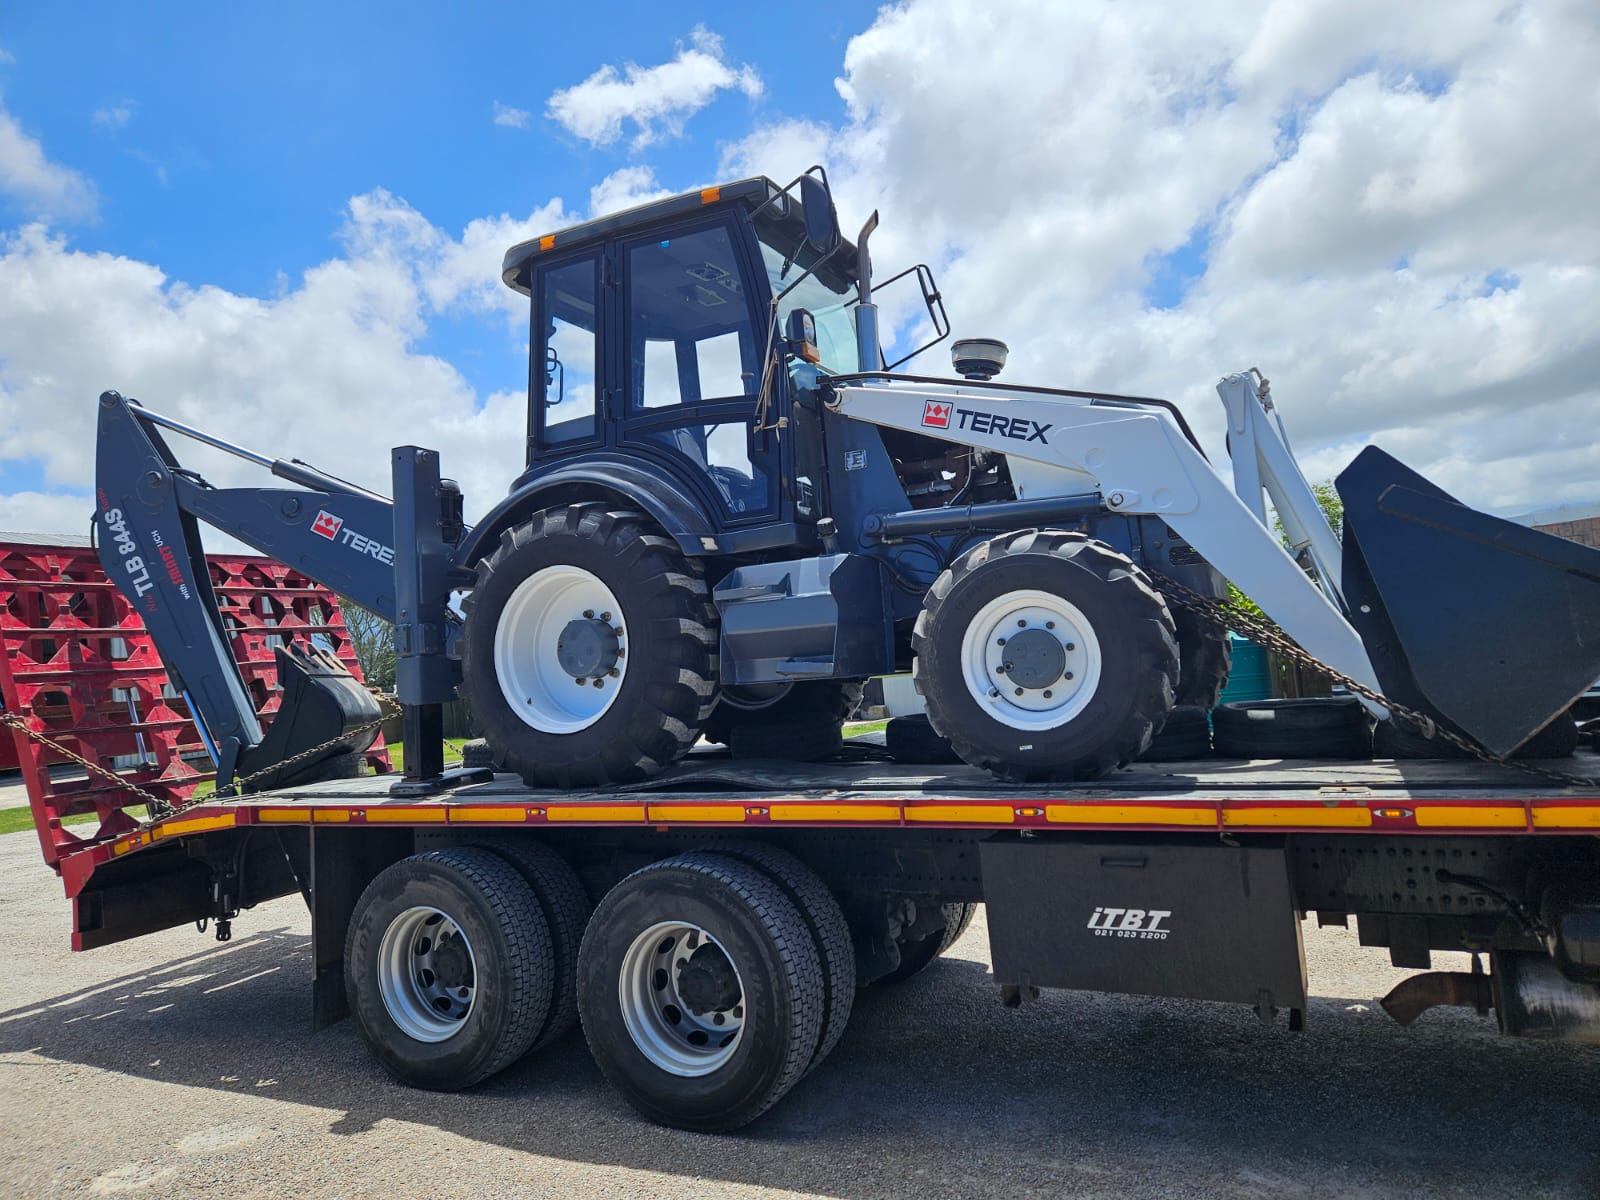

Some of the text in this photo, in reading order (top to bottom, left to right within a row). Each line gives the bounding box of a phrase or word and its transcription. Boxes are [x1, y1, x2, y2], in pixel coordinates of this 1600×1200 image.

[957, 408, 1053, 445] TEREX
[104, 508, 136, 555] 844S
[341, 527, 395, 567] TERE
[125, 556, 154, 598] TLB
[178, 583, 191, 600] with
[1094, 929, 1113, 937] 021
[1140, 931, 1167, 940] 2200
